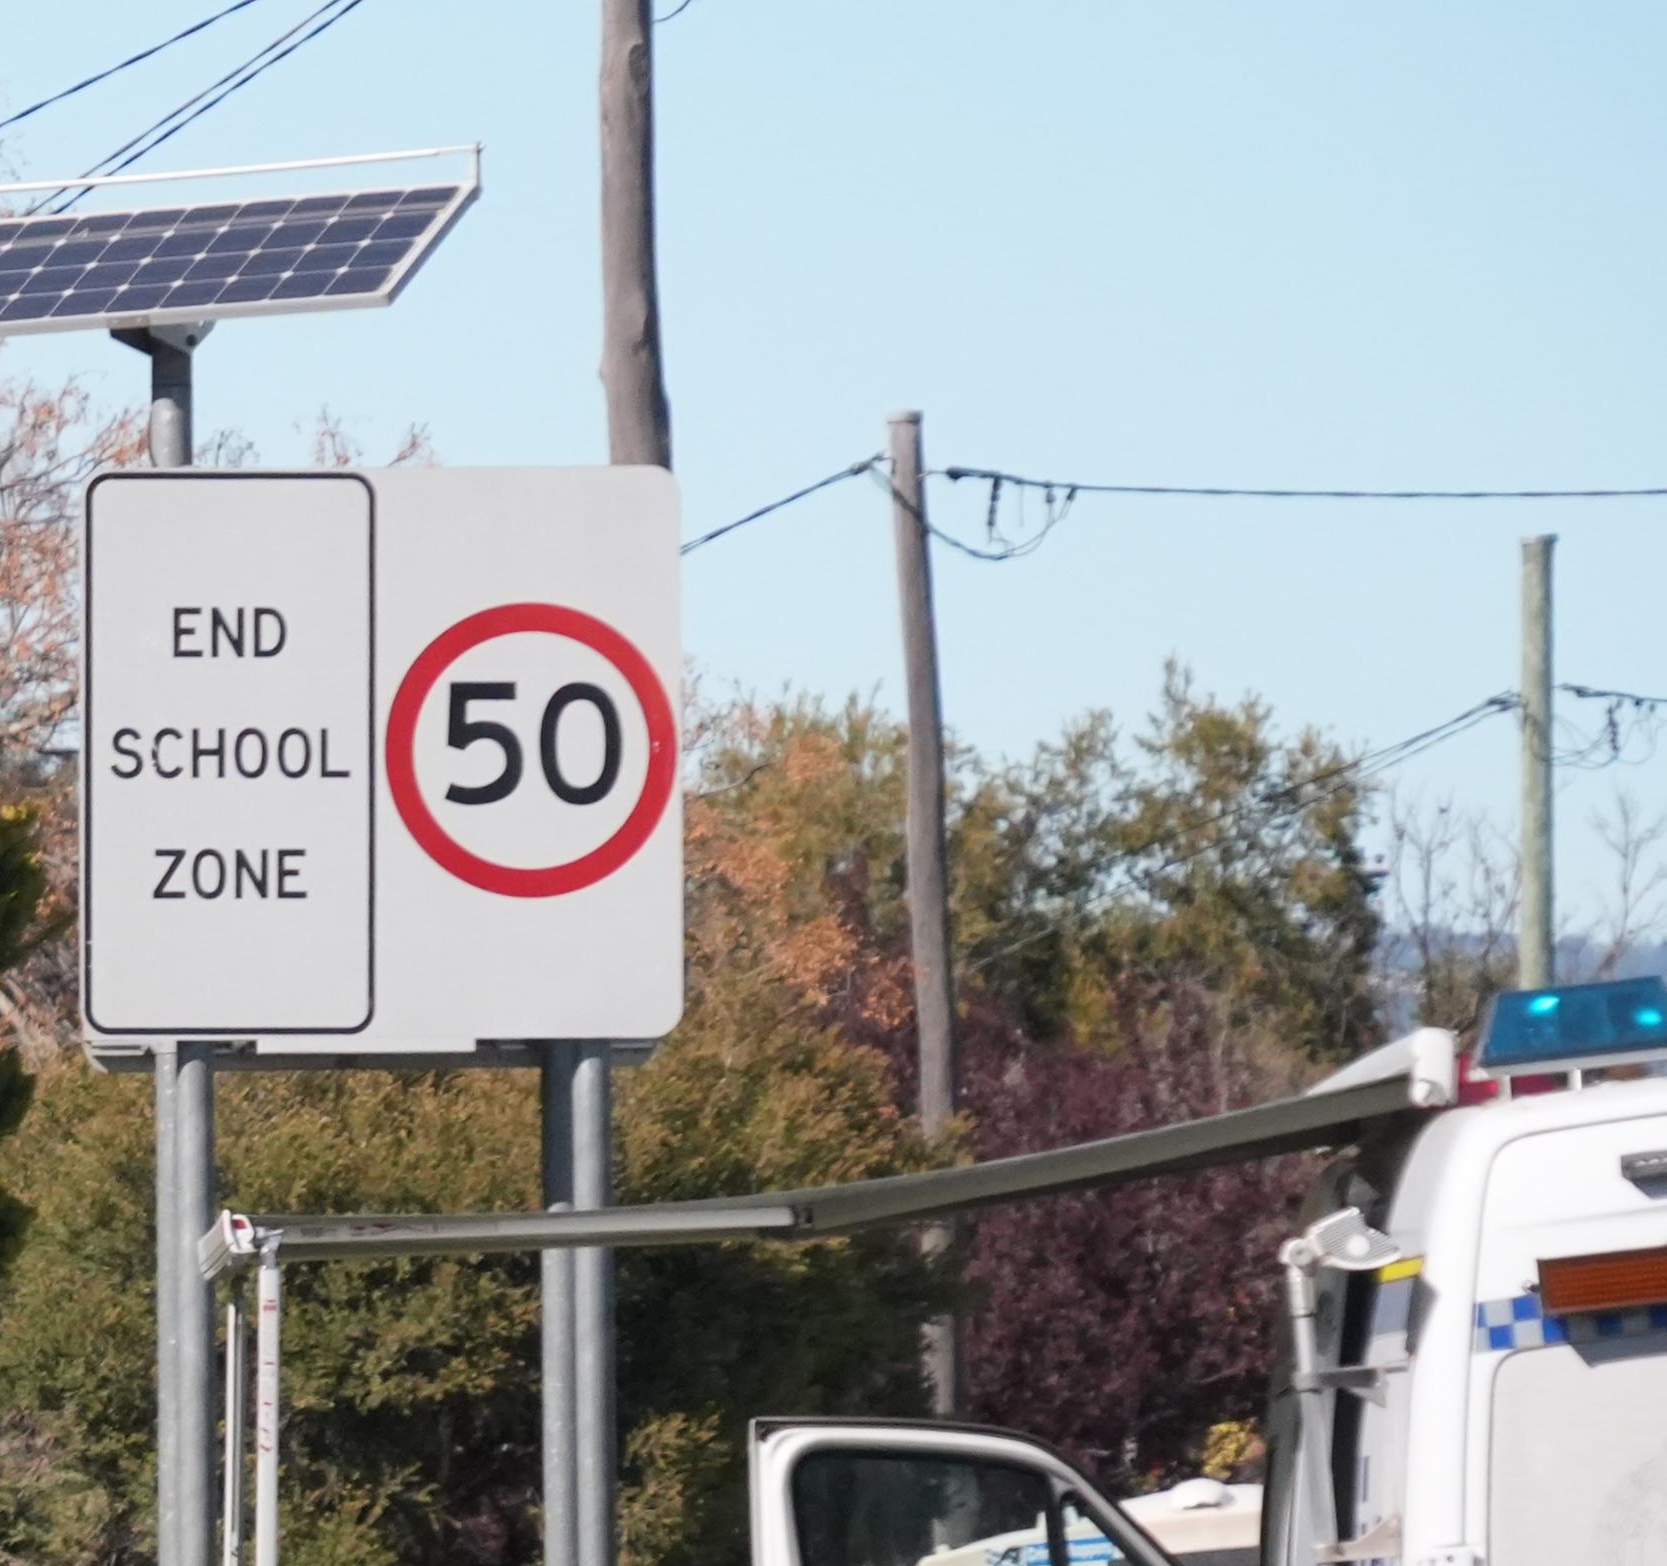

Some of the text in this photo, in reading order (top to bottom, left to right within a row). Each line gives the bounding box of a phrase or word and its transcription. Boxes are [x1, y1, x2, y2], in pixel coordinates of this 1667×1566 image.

[173, 607, 287, 658] END
[110, 728, 351, 779] SCHOOL
[445, 681, 623, 806] 50
[152, 849, 308, 899] ZONE
